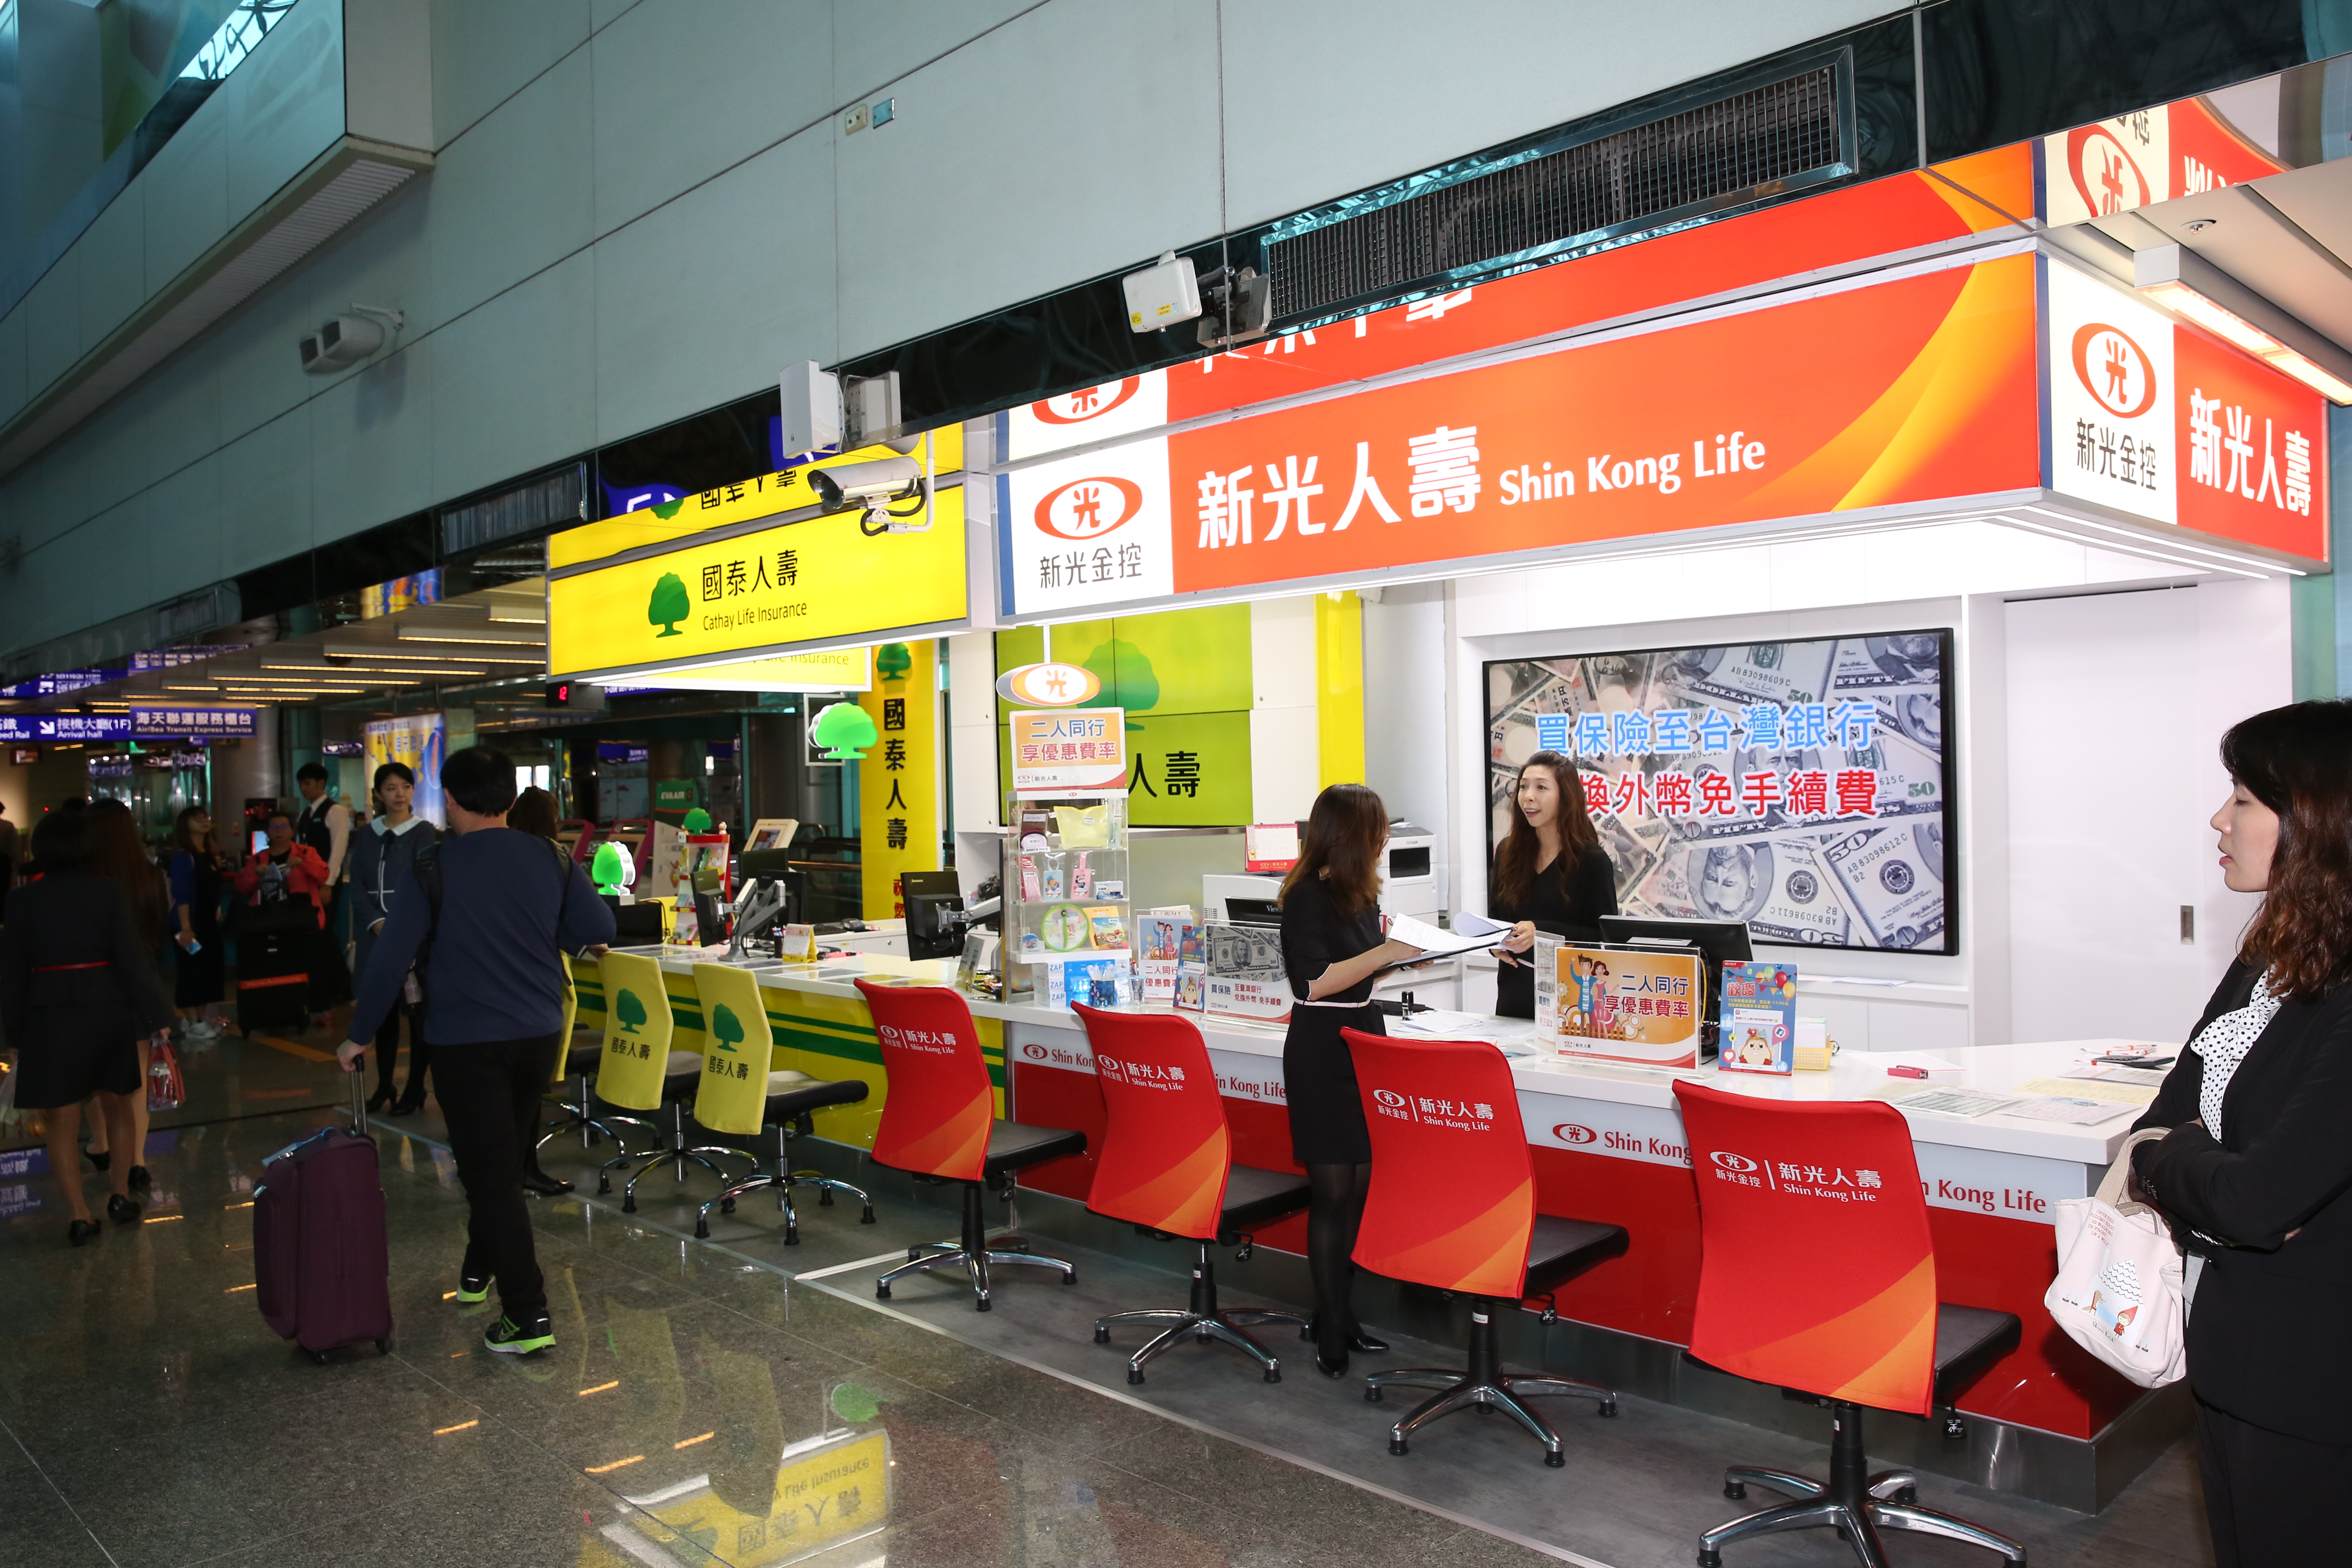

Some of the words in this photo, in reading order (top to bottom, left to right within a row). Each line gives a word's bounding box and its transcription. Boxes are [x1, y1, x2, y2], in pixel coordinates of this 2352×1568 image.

[2076, 417, 2156, 491] 新光金控
[2190, 387, 2311, 517] 新光人壽
[1499, 461, 1574, 505] Shin
[1588, 454, 1681, 494] Kong
[1694, 431, 1765, 478] Life
[1198, 426, 1482, 549] 新光人壽
[703, 550, 797, 601] 國泰人壽
[1039, 542, 1143, 588] 新光金控
[703, 613, 734, 630] Cathay
[737, 608, 755, 625] Life
[758, 603, 807, 622] Insurance
[1031, 718, 1106, 737] 二人同行
[1537, 702, 1877, 755] 買保險至台灣銀行
[1022, 742, 1116, 762] 享優惠費率
[884, 698, 907, 849] 國泰人壽
[1128, 751, 1200, 798] 人壽
[1579, 770, 1877, 816] 換外幣免手續費
[1145, 966, 1178, 975] 二人同行
[1211, 984, 1231, 995] 買保險
[1621, 974, 1688, 996] 二人同行
[1727, 982, 1755, 997] 歡慶
[1604, 995, 1688, 1018] 享優惠費率
[612, 1037, 650, 1060] 國泰人壽
[905, 1029, 956, 1045] 新光人壽
[924, 1045, 942, 1054] Kong
[1051, 1049, 1073, 1064] Shin
[1076, 1053, 1098, 1072] Kon
[709, 1055, 748, 1080] 國泰人壽
[1127, 1062, 1185, 1081] 新光人壽
[1132, 1078, 1146, 1087] Shin
[1148, 1080, 1167, 1091] Kong
[1169, 1082, 1183, 1091] Life
[1215, 1073, 1225, 1089] in
[1230, 1077, 1260, 1098] Kong
[1264, 1082, 1286, 1098] Life
[1378, 1105, 1409, 1120] 新光金控
[1419, 1097, 1494, 1120] 新光人壽
[1423, 1116, 1443, 1126] Shin
[1446, 1118, 1470, 1131] Kong
[1472, 1122, 1490, 1131] Life
[1604, 1131, 1642, 1152] Shin
[1649, 1138, 1693, 1165] Kong
[1715, 1168, 1762, 1188] 新光金控
[1777, 1162, 1882, 1189] 新光人壽
[1783, 1183, 1811, 1196] Shin
[1815, 1187, 1849, 1202] Kong
[1851, 1190, 1876, 1202] Life
[1938, 1179, 1995, 1212] Kong
[2005, 1189, 2046, 1213] Life
